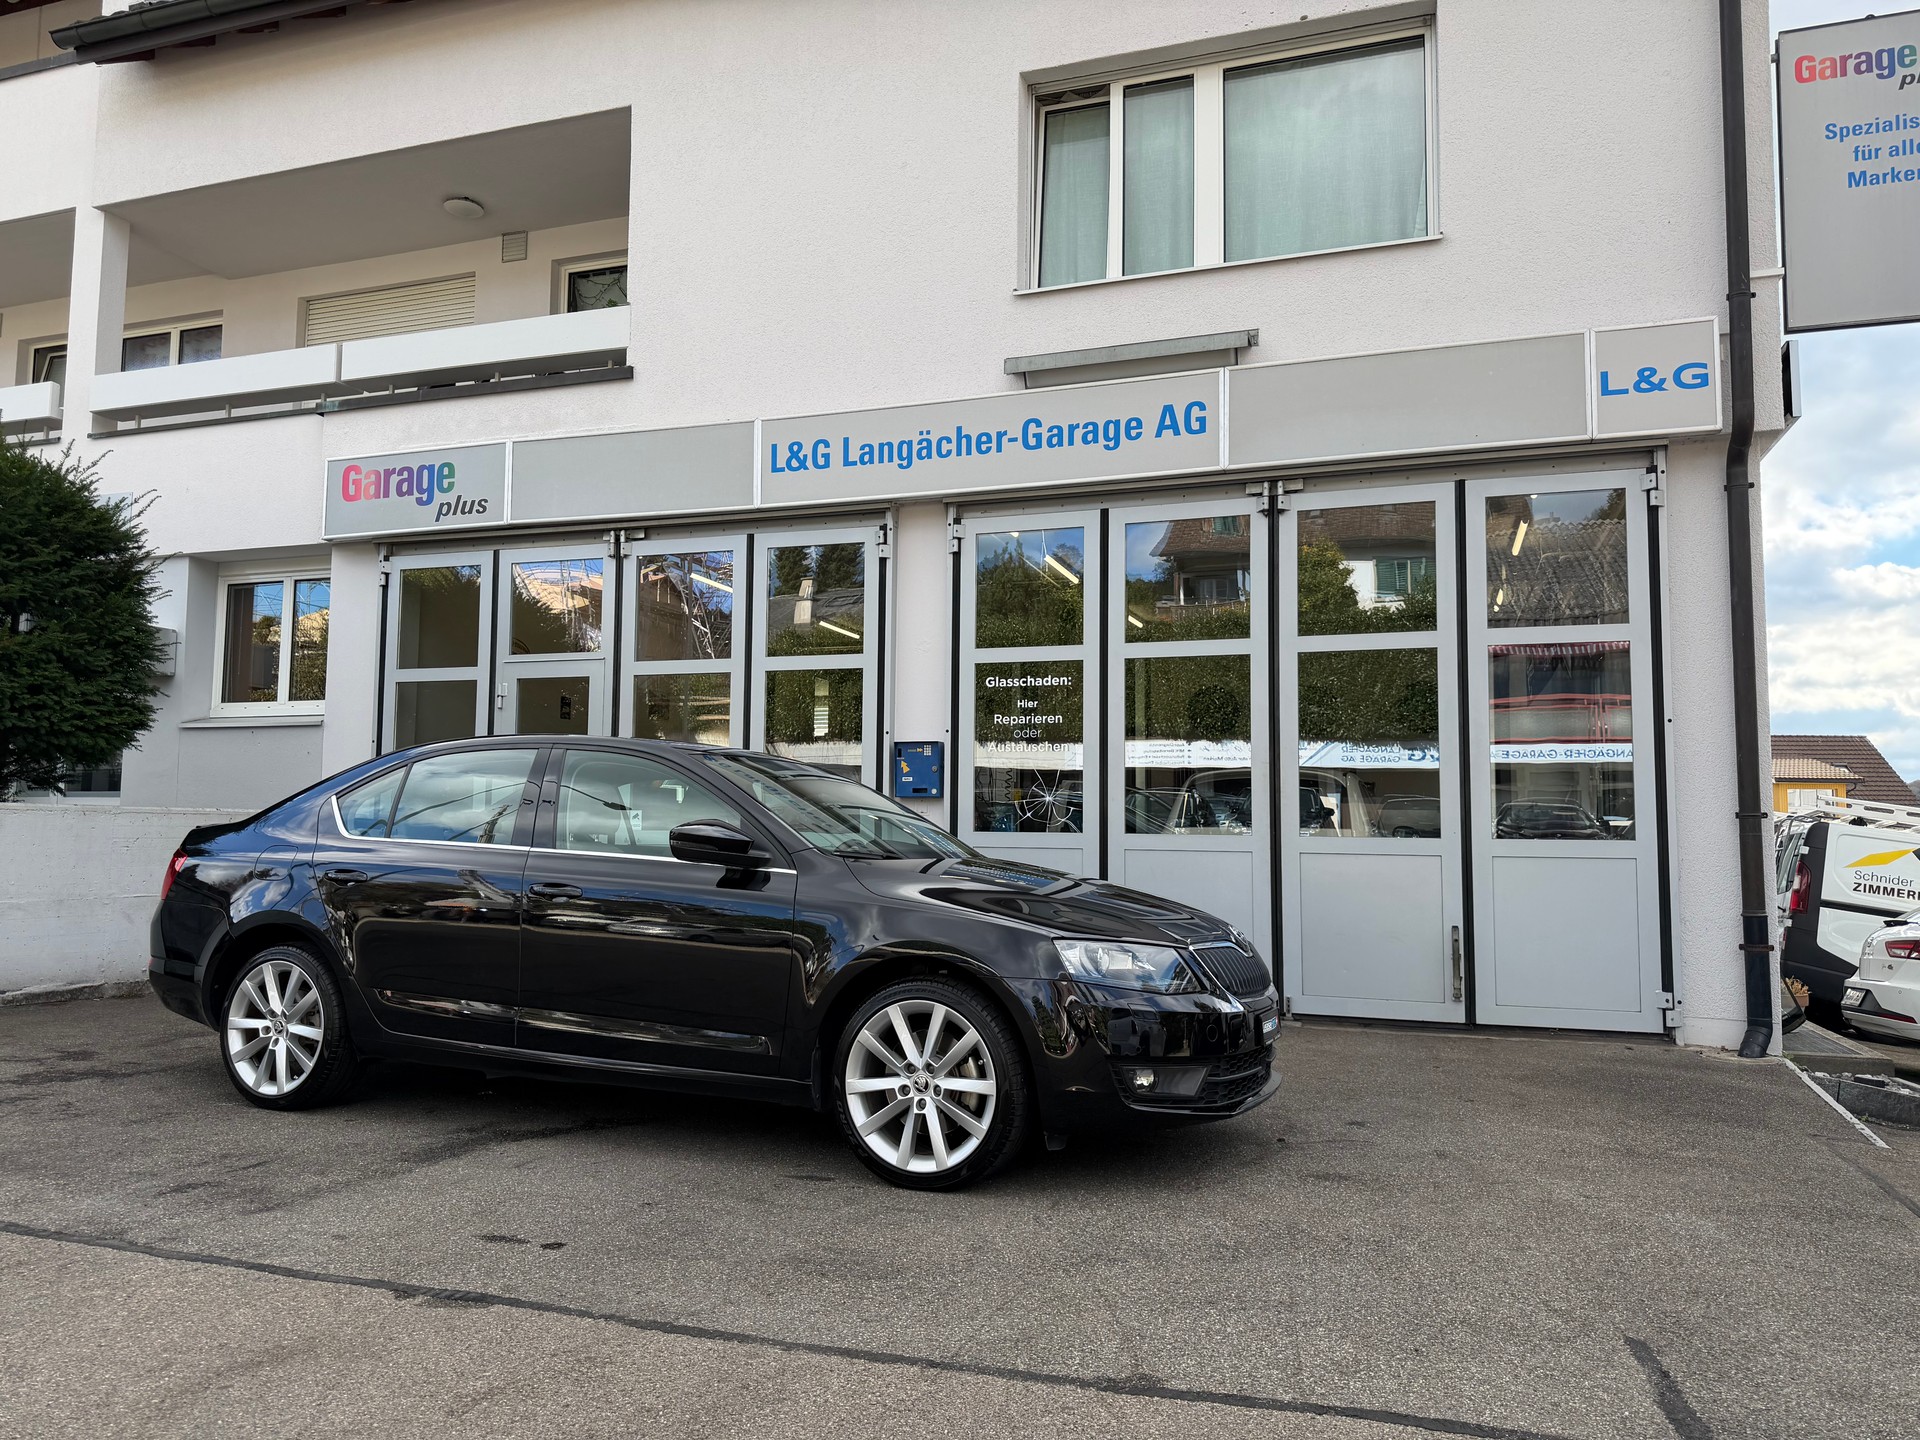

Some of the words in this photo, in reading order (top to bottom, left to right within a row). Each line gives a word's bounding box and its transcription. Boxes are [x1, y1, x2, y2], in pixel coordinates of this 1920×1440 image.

[1794, 44, 1918, 84] Garage
[1852, 144, 1882, 162] für
[1600, 361, 1709, 397] L&G
[770, 437, 831, 474] L&G
[842, 416, 1144, 470] Langächer-Garage
[1154, 400, 1208, 438] AG
[341, 461, 456, 507] Garage
[434, 494, 489, 523] plus
[985, 675, 1072, 688] Glasschaden:
[1017, 699, 1039, 708] Hier
[993, 713, 1063, 725] Reparieren
[1013, 728, 1042, 738] oder
[1853, 869, 1914, 887] Schnider
[1852, 881, 1920, 900] ZIMMER
